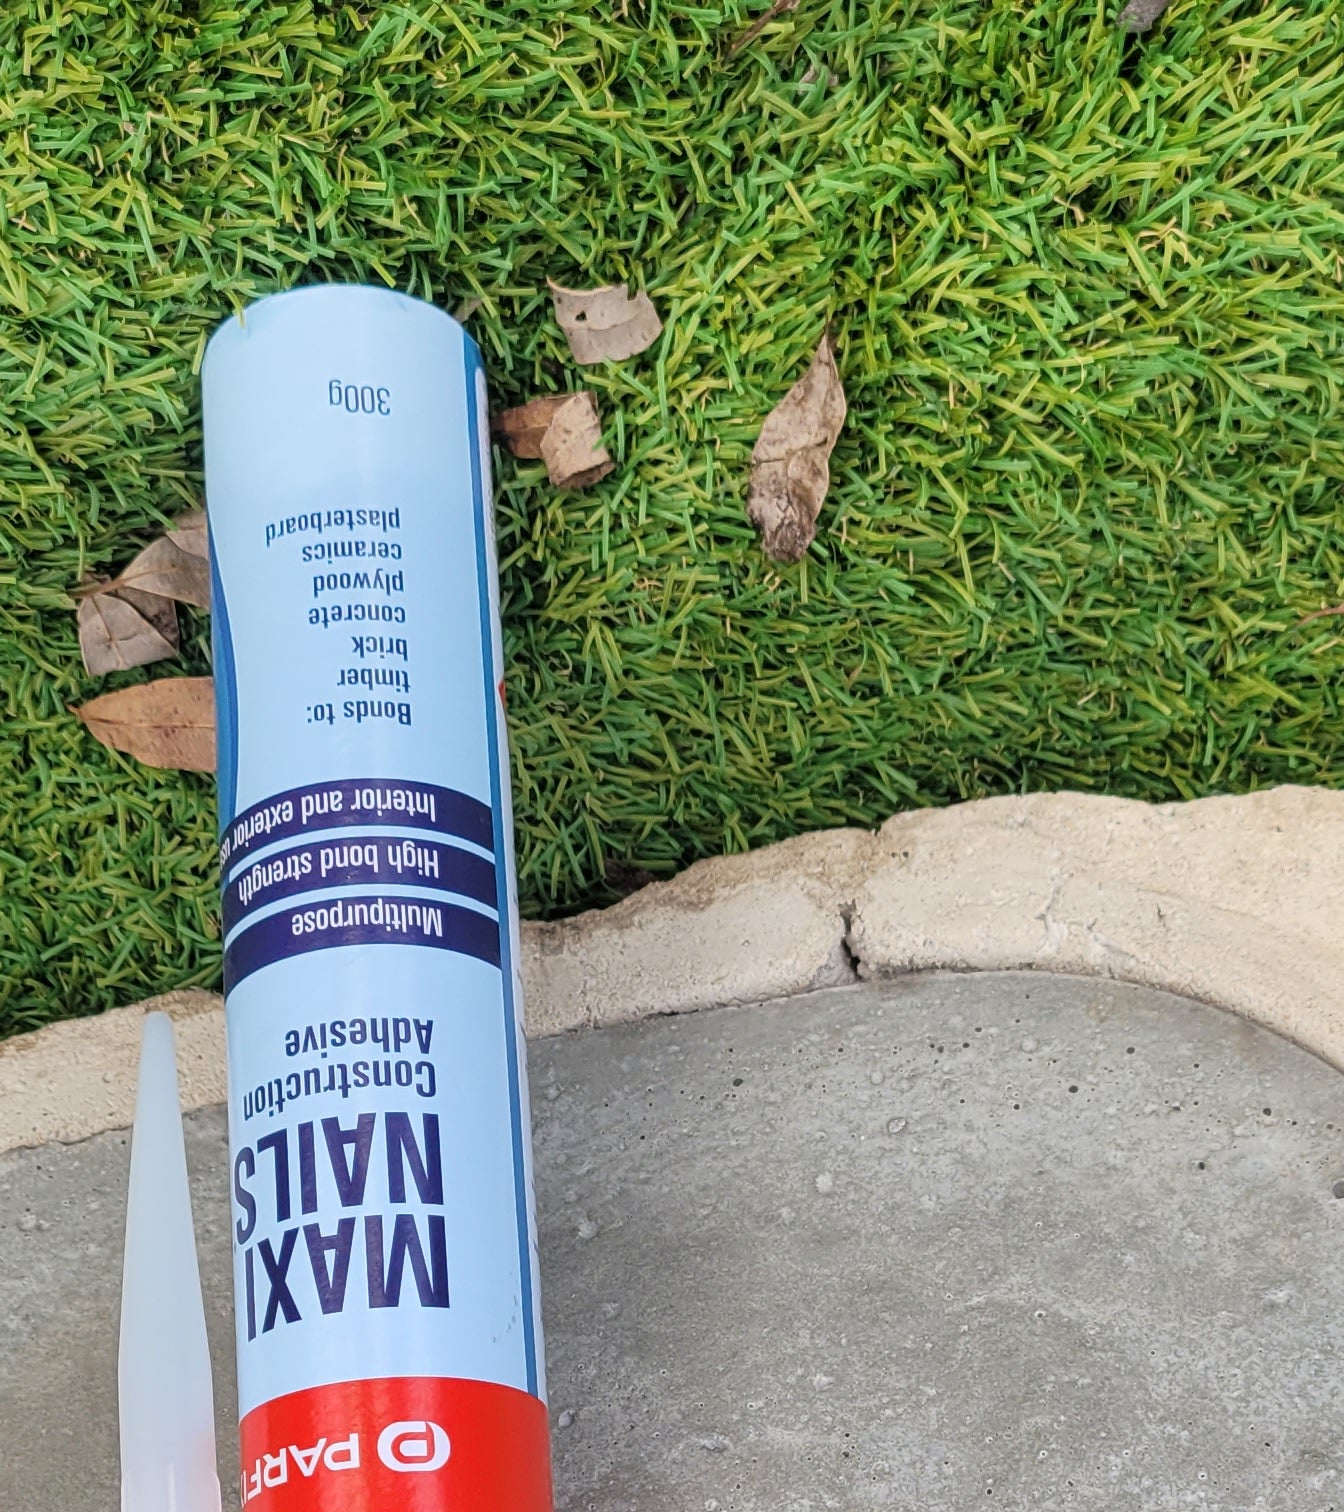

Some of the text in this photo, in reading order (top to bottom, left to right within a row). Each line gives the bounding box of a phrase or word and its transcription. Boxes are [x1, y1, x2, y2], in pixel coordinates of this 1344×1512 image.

[328, 379, 391, 415] 300g
[265, 508, 400, 547] plasterboard
[302, 541, 402, 564] ceramics
[313, 570, 404, 598] plywood
[308, 604, 406, 628] concrete
[352, 636, 408, 661] brick
[337, 668, 411, 693] timber
[307, 701, 412, 726] Bonds to:
[301, 789, 343, 824] and
[351, 787, 436, 823] Interior
[232, 800, 293, 851] exterior
[238, 840, 440, 906] High bond strength
[291, 898, 443, 937] Multipurpose
[285, 1017, 435, 1058] Adhesive
[243, 1060, 436, 1122] Construction
[234, 1111, 444, 1246] NAILS
[245, 1214, 450, 1342] MAXI
